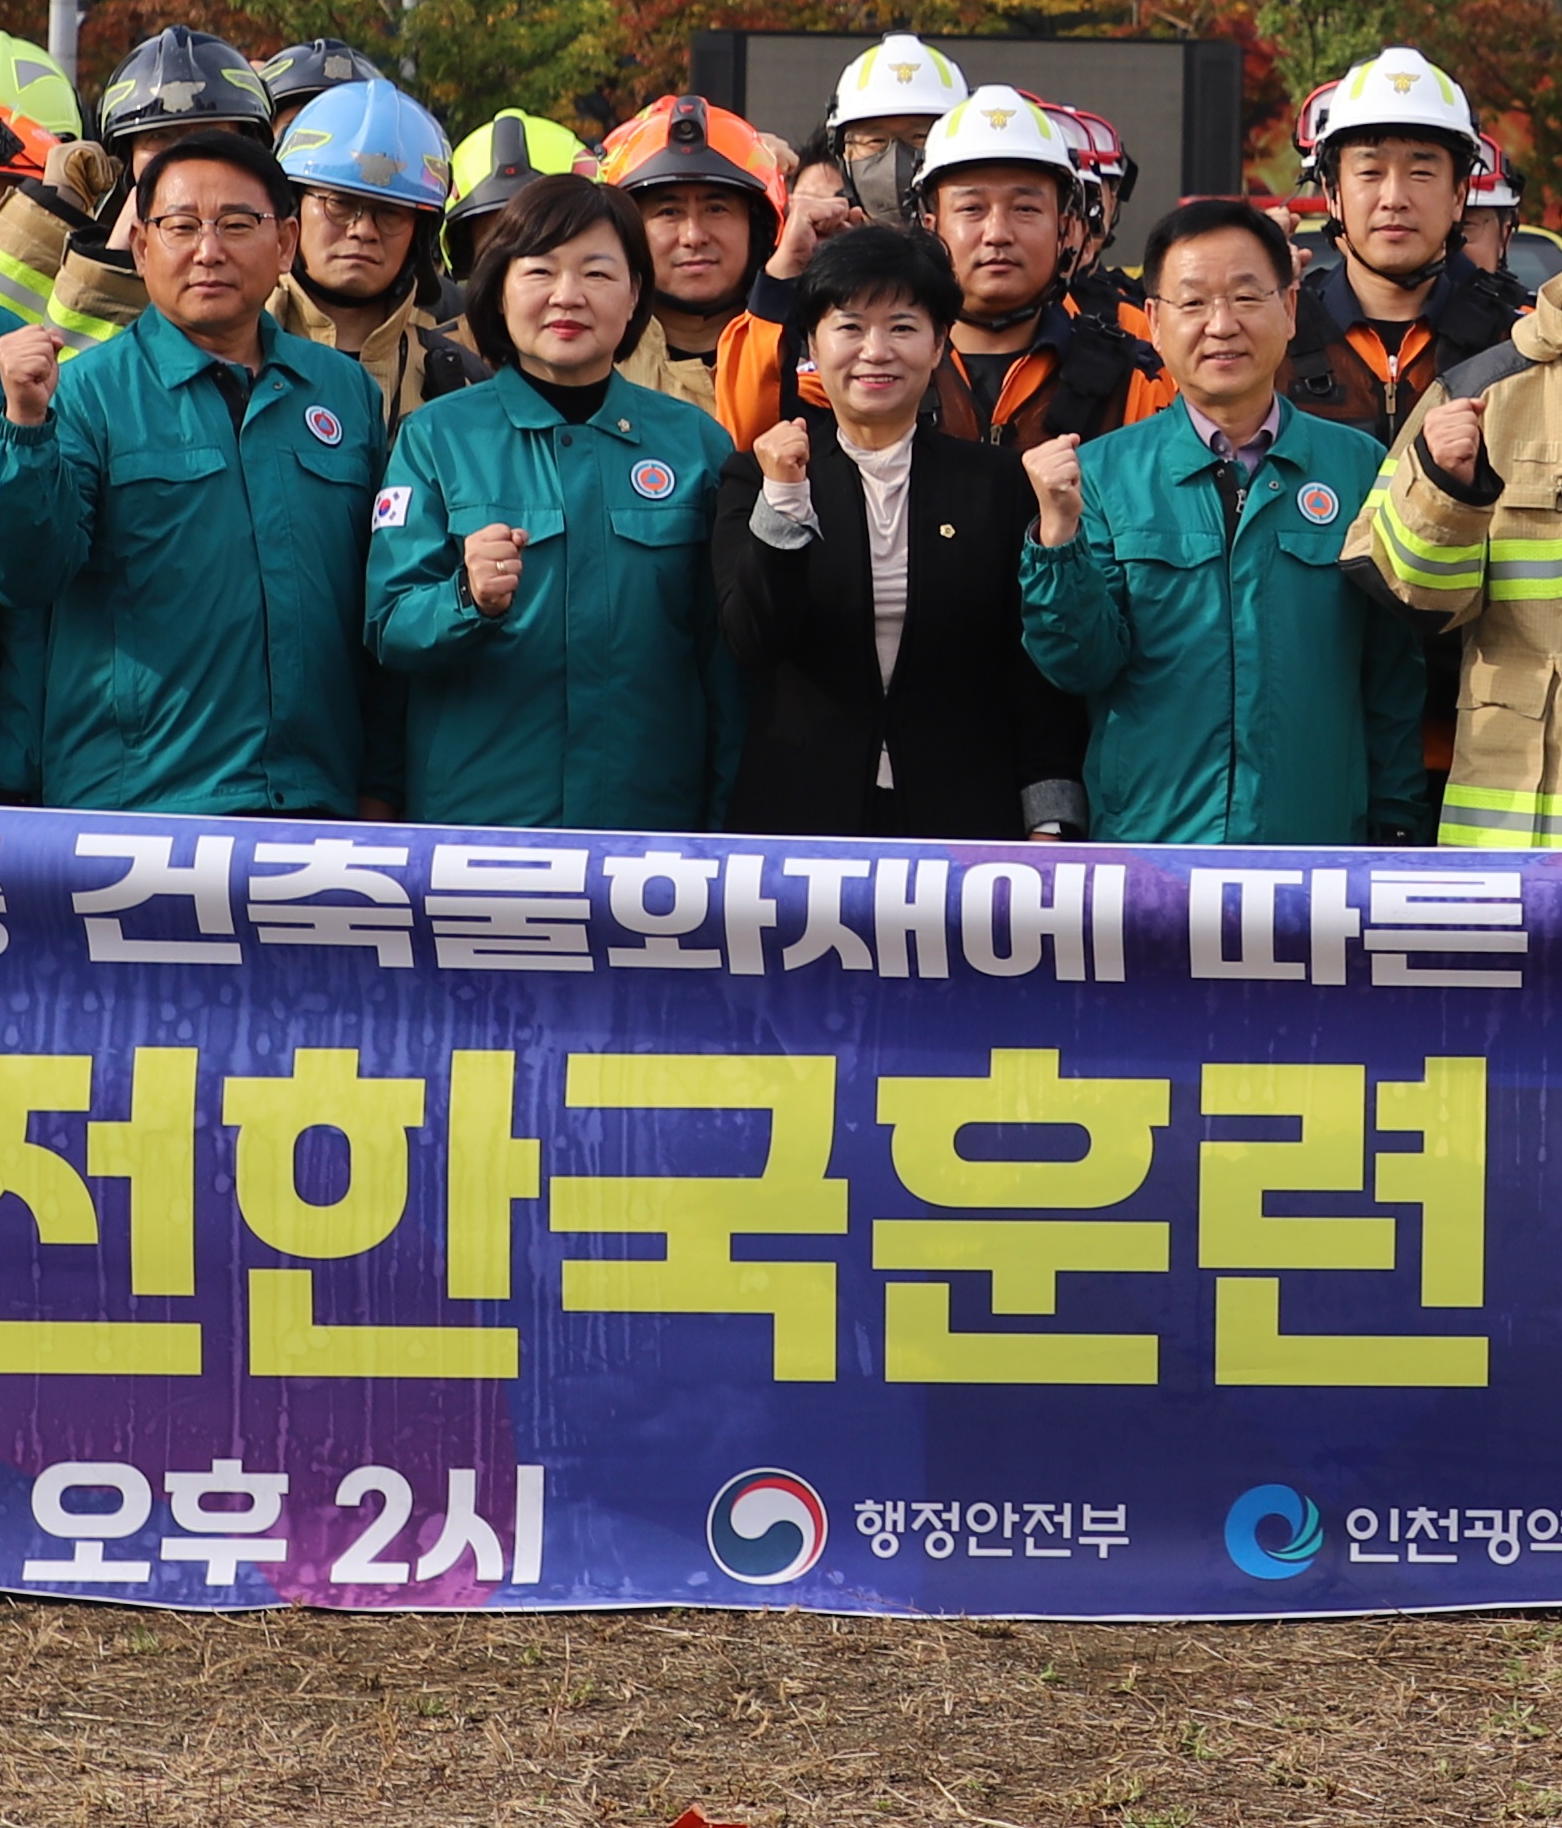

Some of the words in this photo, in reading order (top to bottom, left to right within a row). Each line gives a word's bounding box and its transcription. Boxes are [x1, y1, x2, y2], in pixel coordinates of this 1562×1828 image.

[71, 832, 1129, 984] 건축물화재에
[1186, 862, 1527, 990] 따른
[20, 1458, 290, 1587] 오후
[328, 1464, 545, 1587] 2시
[853, 1498, 1131, 1560] 행정안전부
